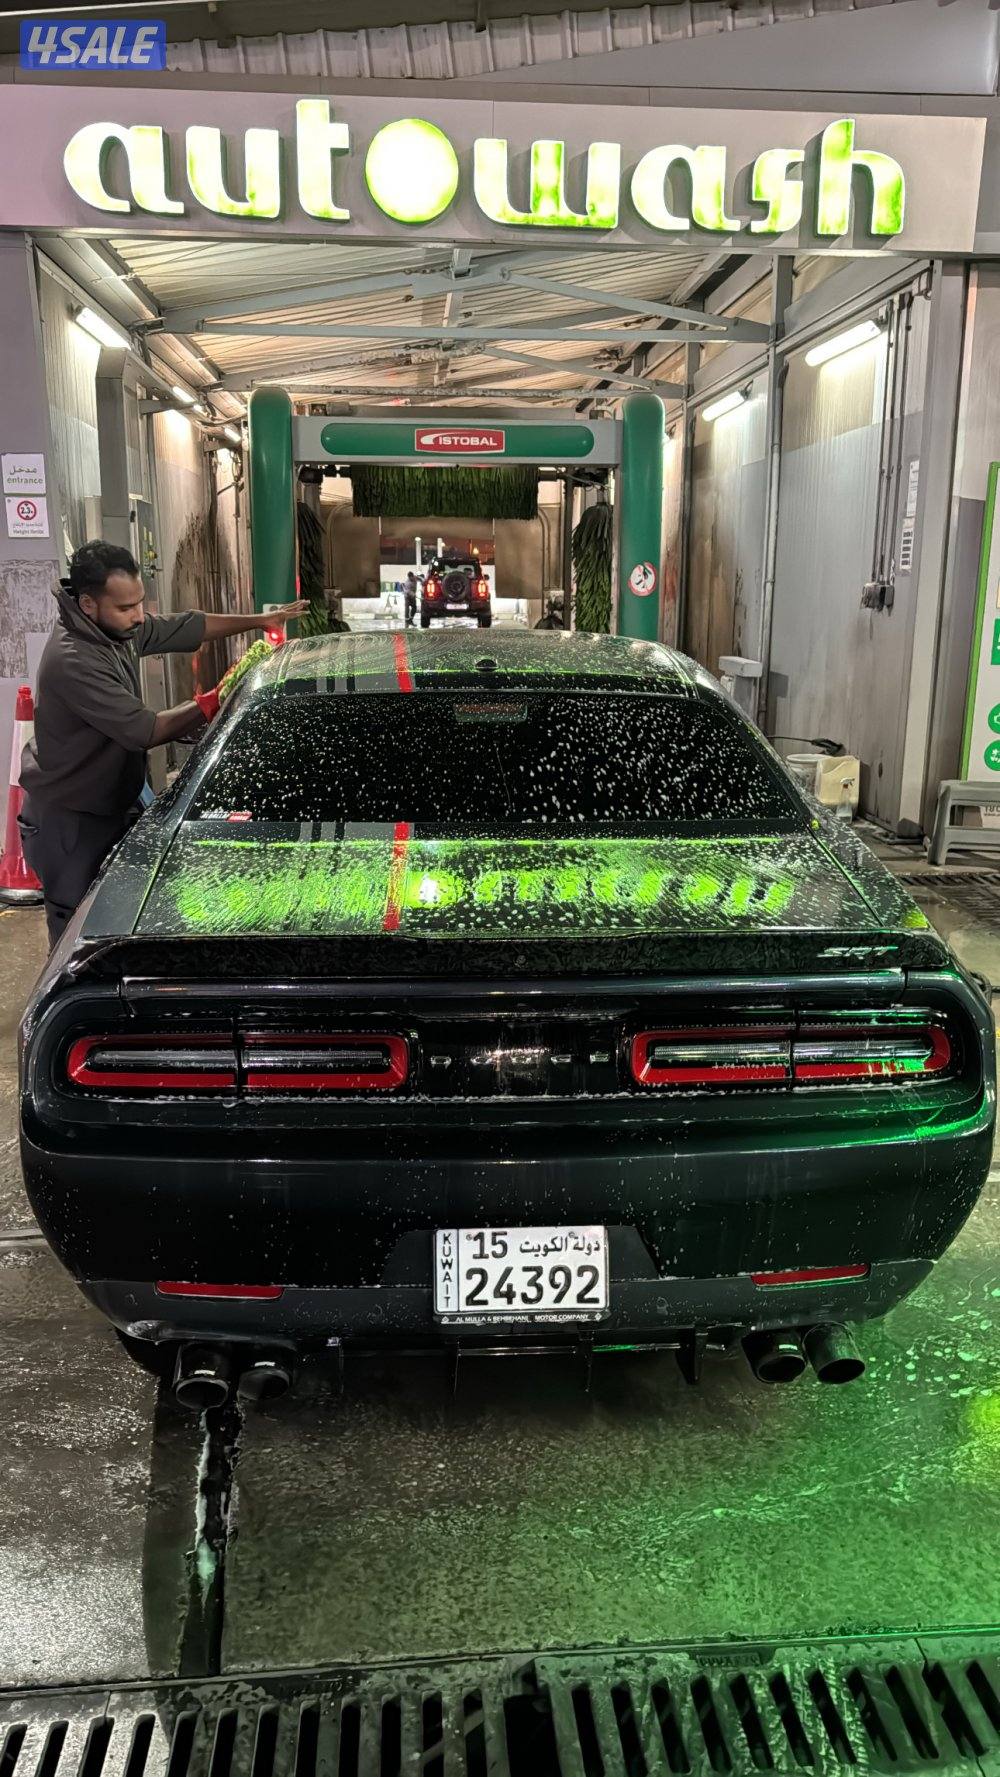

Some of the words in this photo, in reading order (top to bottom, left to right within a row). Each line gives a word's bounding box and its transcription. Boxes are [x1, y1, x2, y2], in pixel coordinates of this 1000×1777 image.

[438, 436, 498, 446] ISTOBAL
[7, 476, 43, 484] entrance
[472, 1231, 509, 1260] 15
[519, 1235, 569, 1257] الكويت
[572, 1236, 600, 1256] دولة
[441, 1233, 453, 1309] KUWAIT
[465, 1264, 600, 1306] 24392
